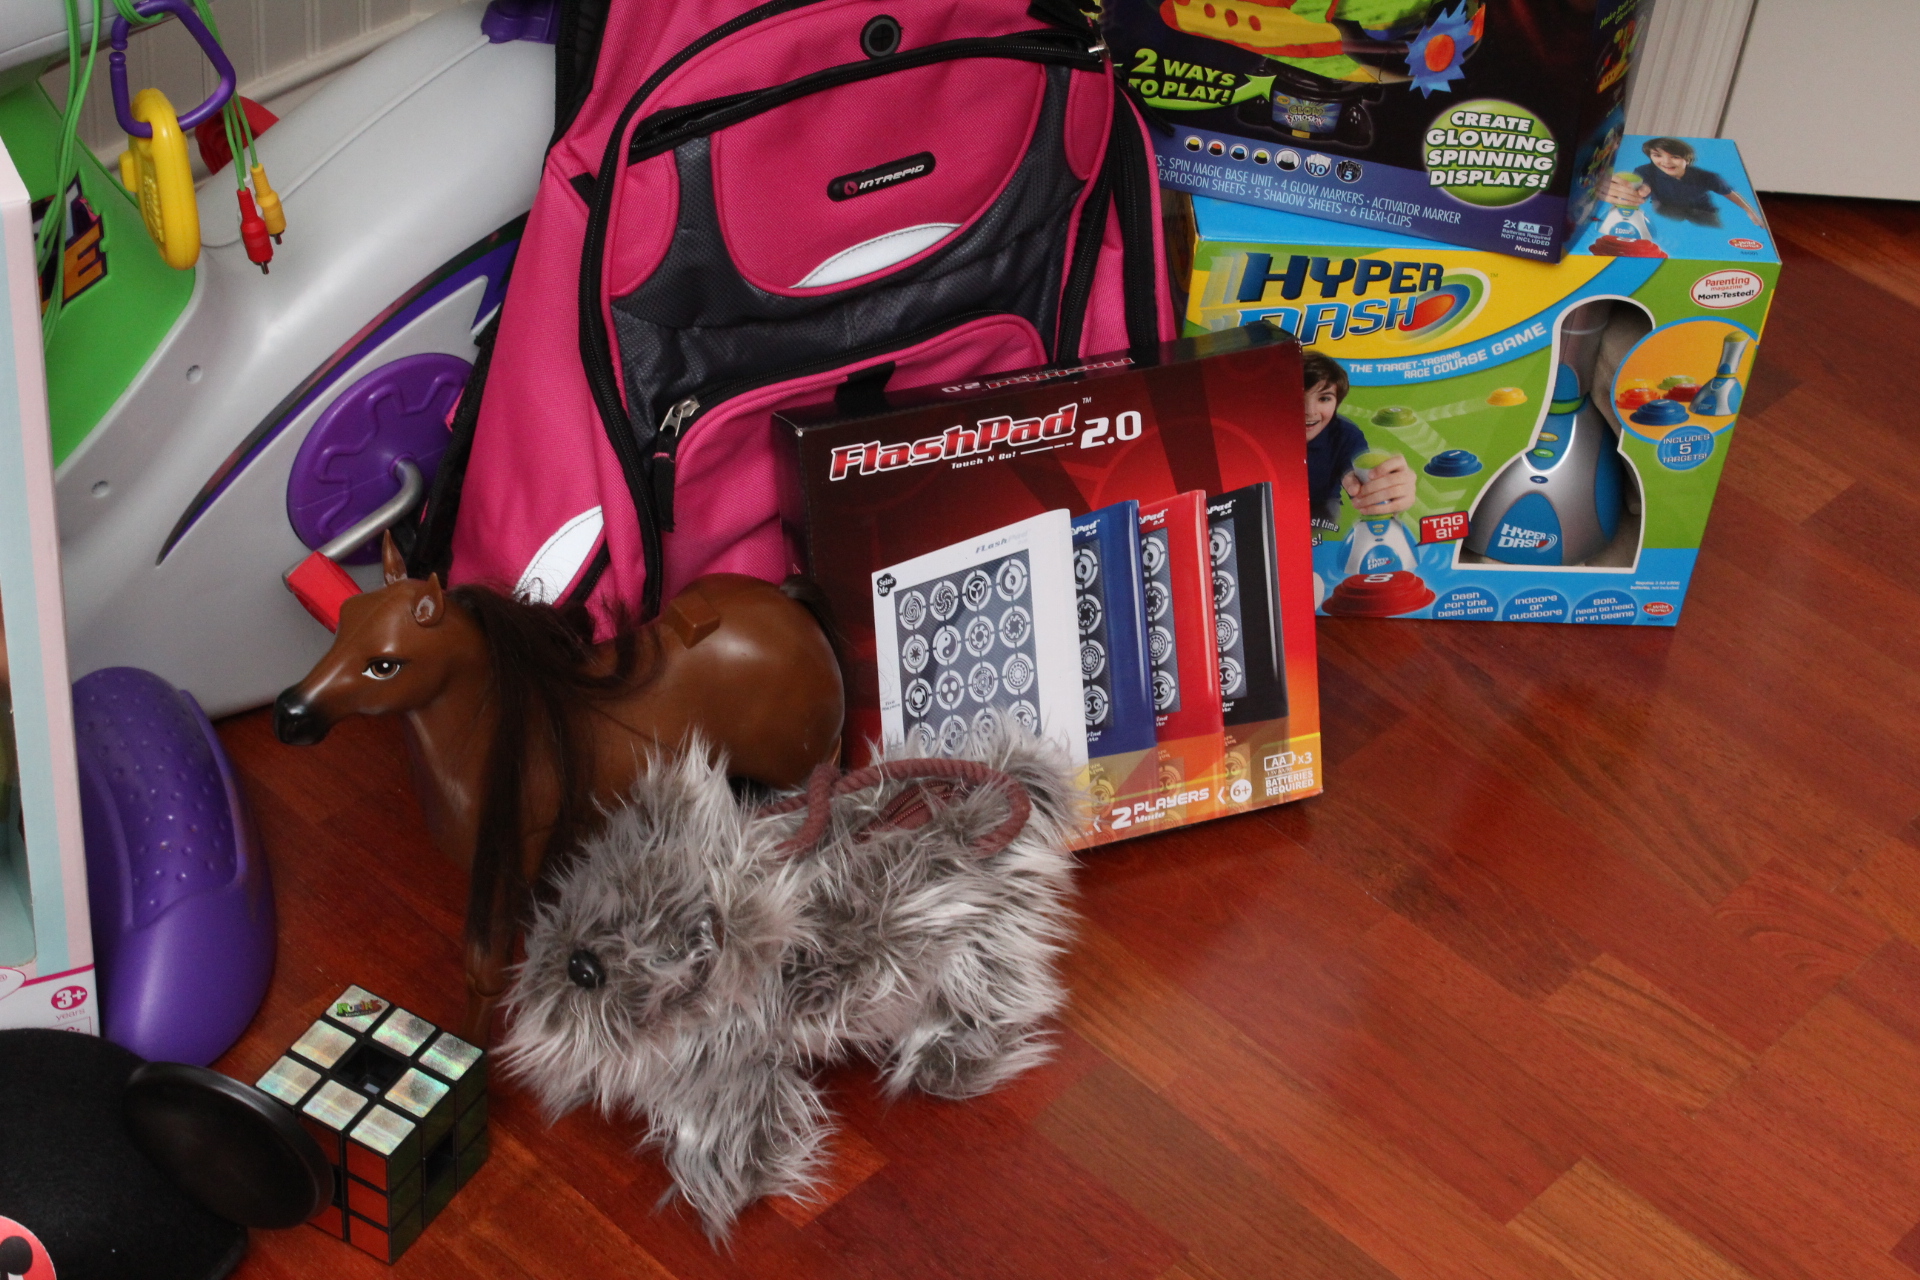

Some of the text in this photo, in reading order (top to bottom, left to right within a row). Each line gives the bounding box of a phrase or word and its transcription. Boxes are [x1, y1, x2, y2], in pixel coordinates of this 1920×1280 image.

[1131, 48, 1236, 87] 2 WAYS
[1162, 80, 1231, 102] PLAY!
[1289, 105, 1325, 116] GLOW
[1285, 113, 1328, 127] EXPLOSION
[1451, 112, 1531, 132] CREATE
[1426, 130, 1555, 153] GLOWING
[1427, 150, 1554, 171] SPINNING
[1310, 163, 1326, 175] 10
[1344, 171, 1353, 180] 5
[859, 164, 924, 189] INTREPID
[1430, 170, 1549, 188] DISPLAYS!
[1159, 168, 1413, 228] EXPLOSION SHEETS 5 SHADOW SHEETS 6 FLEXI-CLIPS
[1169, 158, 1190, 173] SPIN
[1193, 162, 1222, 179] MAGIC
[1225, 168, 1249, 184] BASE
[1251, 173, 1274, 187] UNIT
[1281, 180, 1287, 190] 4
[1290, 181, 1318, 196] GLOW
[1320, 188, 1364, 205] MARKERS
[1371, 197, 1421, 217] ACTIVATOR
[1422, 208, 1461, 225] MARKER
[1503, 219, 1517, 229] 2x
[1516, 236, 1550, 246] INCLUDED
[1514, 244, 1549, 257] Nontoxic
[1236, 252, 1444, 302] HYPER
[1705, 277, 1750, 287] Parenting
[1698, 290, 1755, 300] Mom-Tested!
[1237, 296, 1418, 346] DASH
[1404, 322, 1547, 379] RACE COURSE GAME
[1350, 351, 1461, 373] THE TARGET-TAGGING
[829, 402, 1078, 481] FlashPad
[1080, 410, 1142, 449] 2.0
[1663, 434, 1710, 444] INCLUDES
[1679, 443, 1692, 455] 5
[951, 457, 983, 470] Touch
[987, 454, 995, 463] N
[1662, 453, 1709, 463] TARGETS!
[1322, 519, 1339, 532] time
[1501, 523, 1547, 540] HYPER
[1498, 536, 1539, 548] DASH
[878, 585, 889, 595] Me
[1451, 592, 1480, 600] Dash
[1515, 595, 1558, 605] Indoors
[1467, 606, 1494, 614] time
[1509, 609, 1563, 620] outdoors
[1575, 605, 1597, 615] head
[1271, 752, 1313, 767] AA x3
[1265, 770, 1314, 788] BATTERIES
[1233, 785, 1250, 797] 6+
[1266, 778, 1314, 796] REQUIRED
[1111, 788, 1209, 829] 2 PLAYERS
[1134, 811, 1165, 823] Mode
[57, 990, 86, 1009] 3+
[56, 1008, 85, 1021] years
